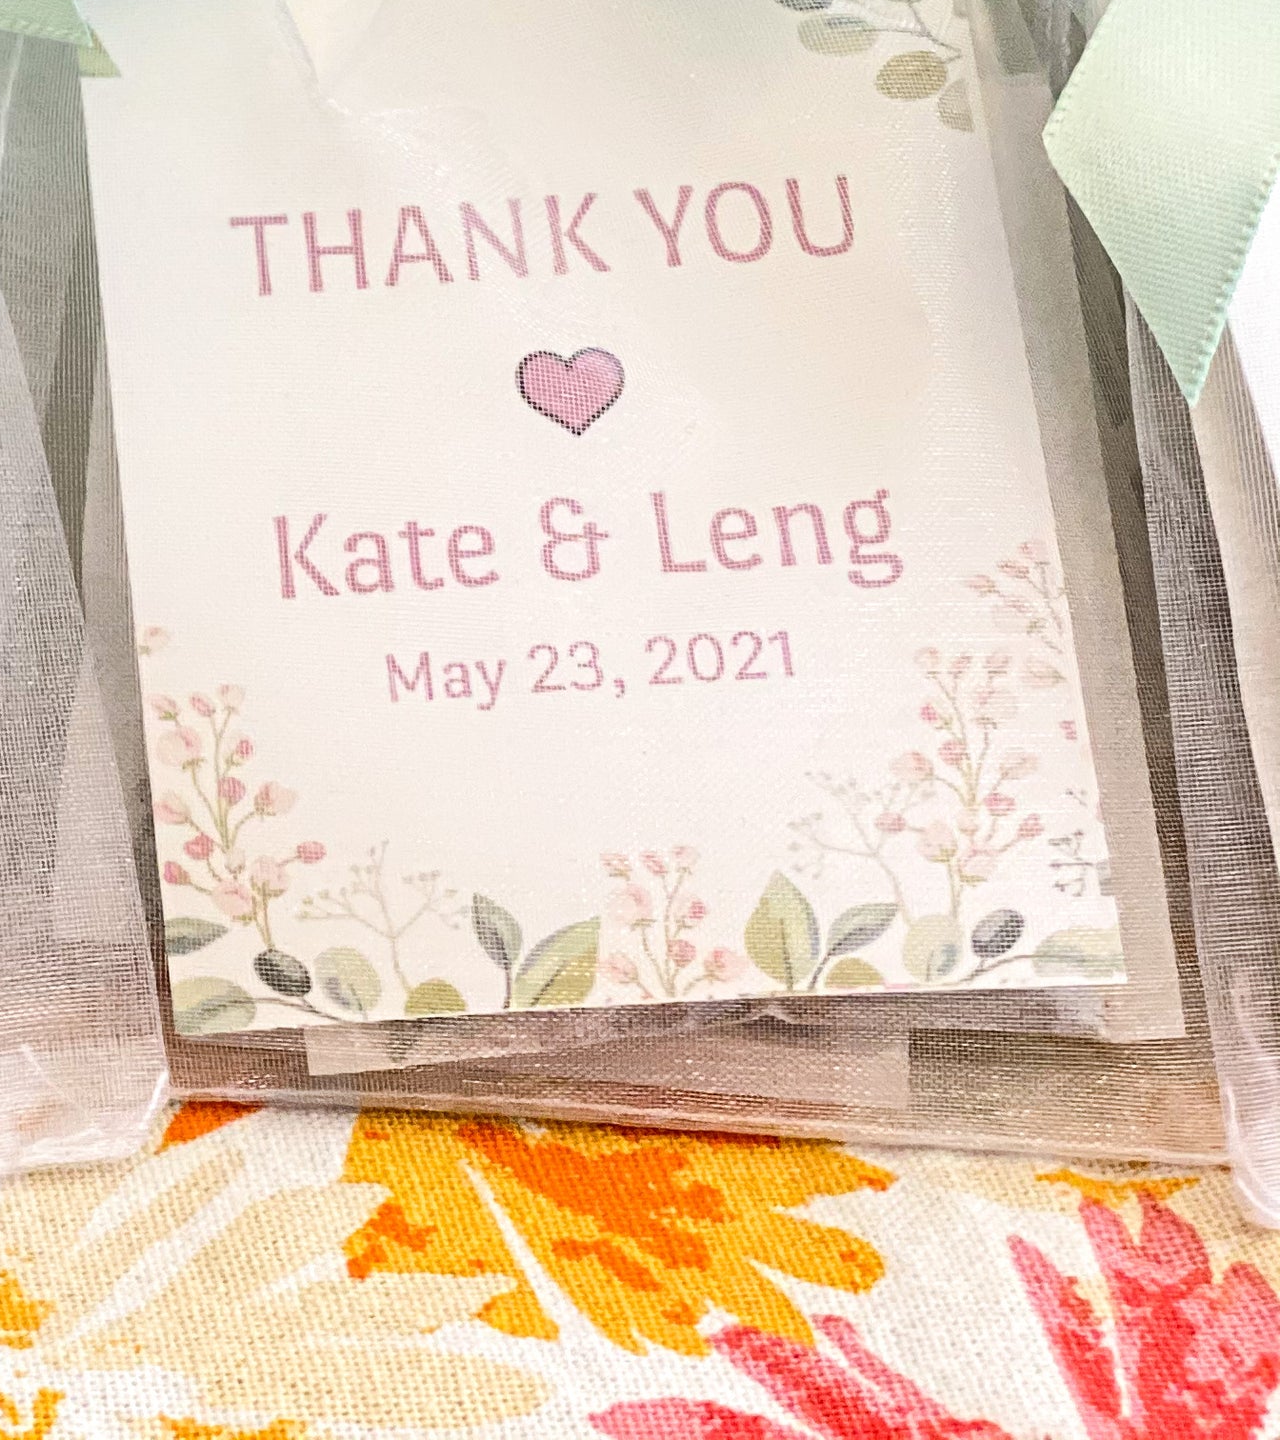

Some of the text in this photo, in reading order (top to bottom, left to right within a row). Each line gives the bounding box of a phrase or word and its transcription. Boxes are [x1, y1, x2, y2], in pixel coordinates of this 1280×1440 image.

[229, 174, 855, 297] THANK YOU
[273, 488, 905, 600] Kate & Leng
[384, 630, 796, 712] May 23, 2021
